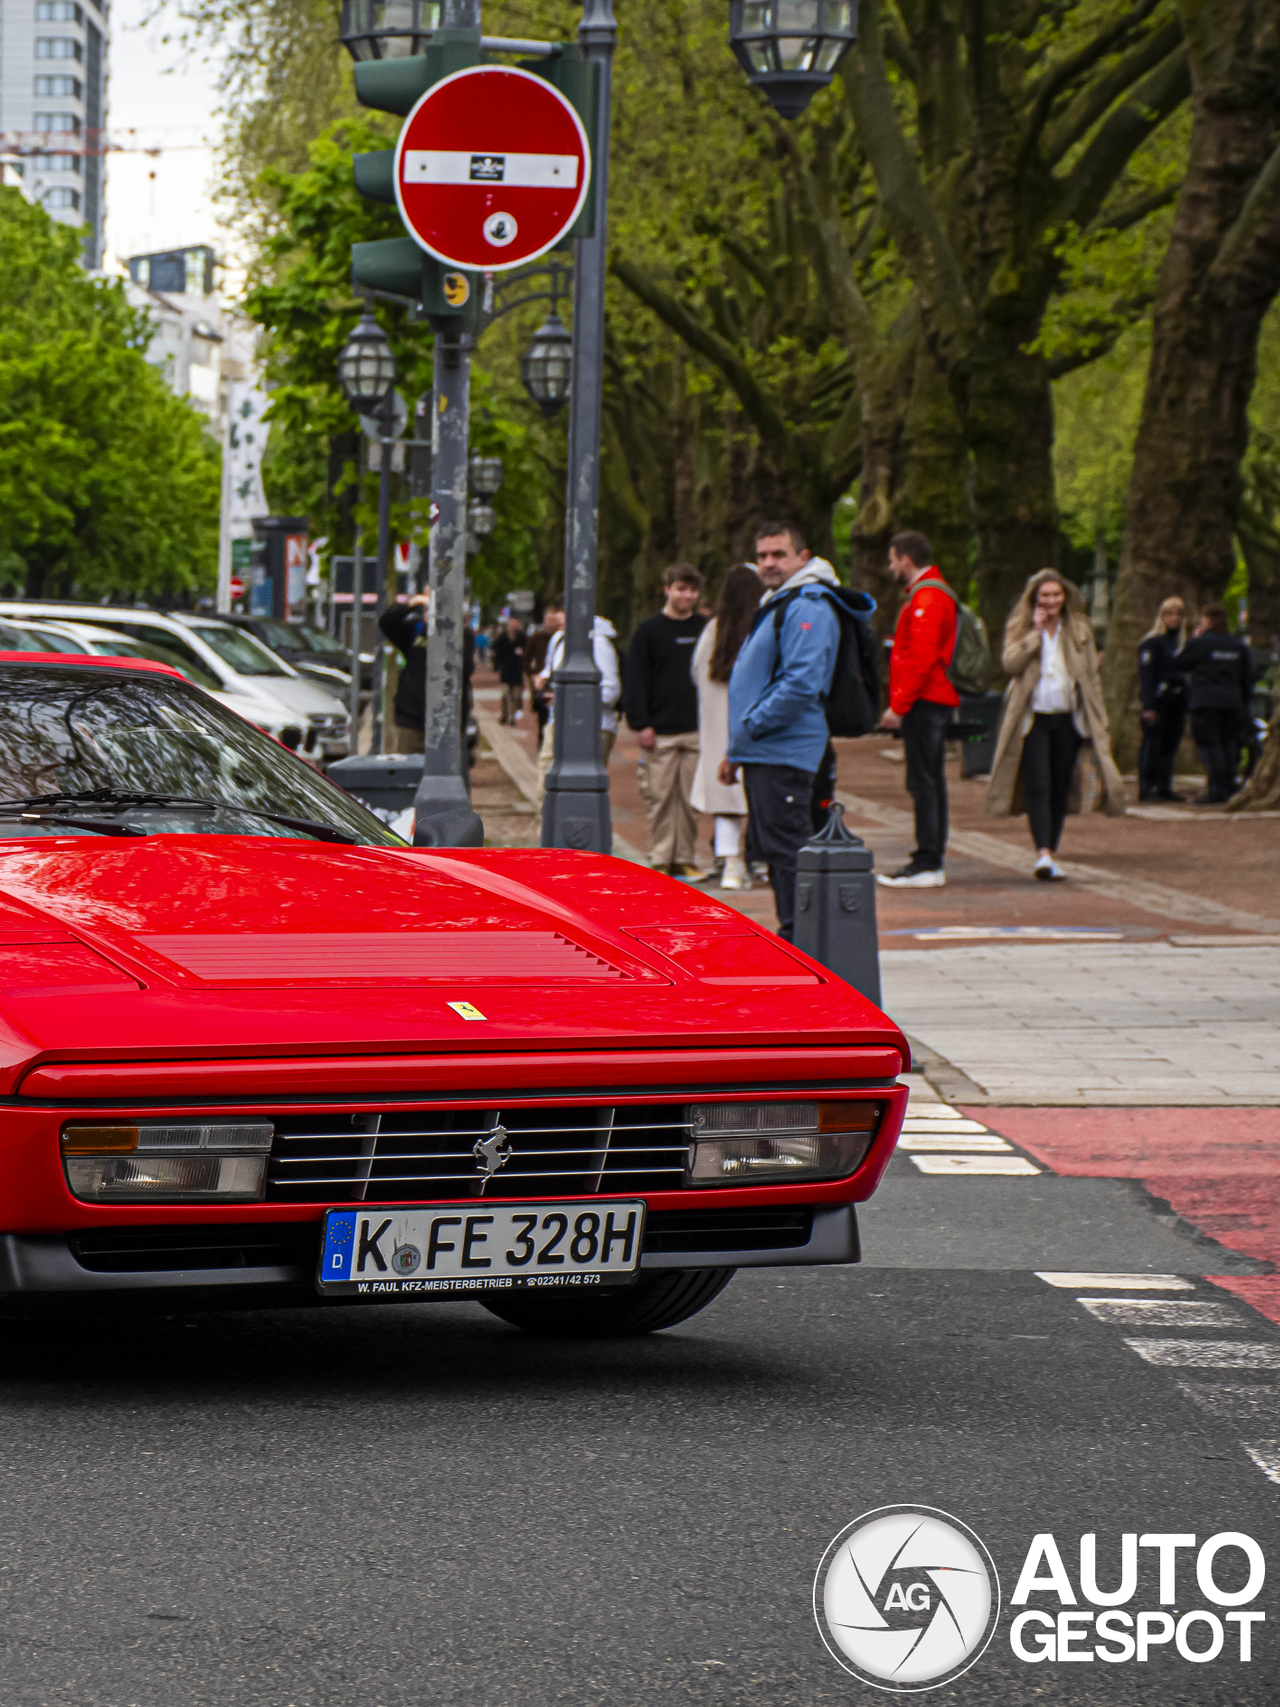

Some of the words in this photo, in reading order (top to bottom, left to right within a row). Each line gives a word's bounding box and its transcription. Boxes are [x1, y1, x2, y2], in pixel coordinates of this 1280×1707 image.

[356, 1218, 393, 1272] K
[426, 1215, 495, 1270] FE
[505, 1211, 637, 1267] 328H
[332, 1253, 343, 1270] D
[357, 1282, 371, 1293] W.
[372, 1282, 400, 1293] FAUL
[401, 1277, 513, 1292] KFZ-MEISTERBETRIEB
[583, 1274, 601, 1284] 573
